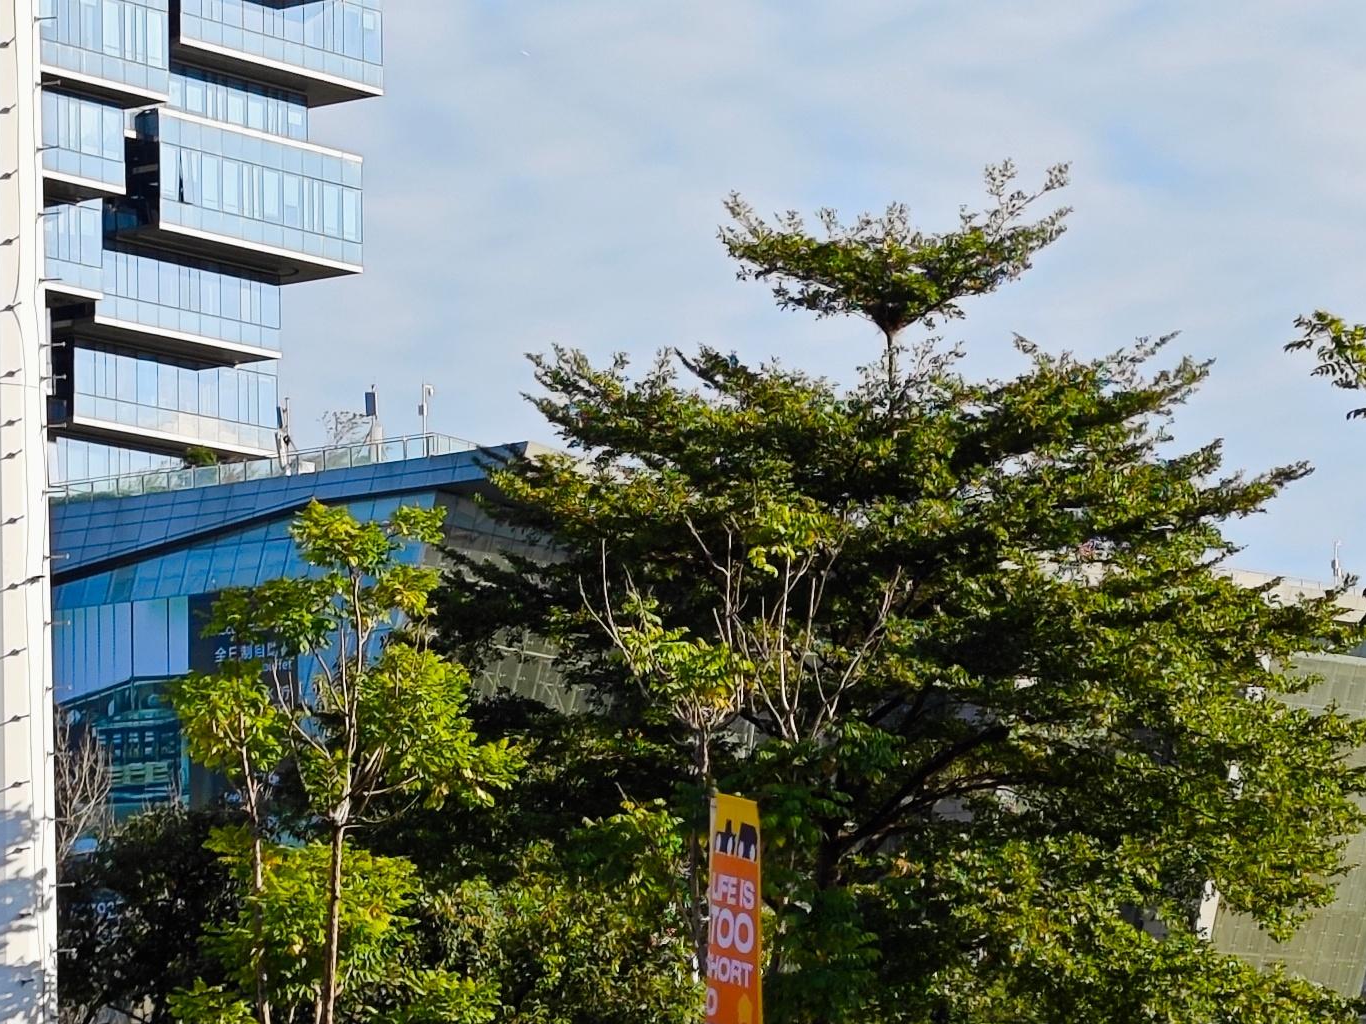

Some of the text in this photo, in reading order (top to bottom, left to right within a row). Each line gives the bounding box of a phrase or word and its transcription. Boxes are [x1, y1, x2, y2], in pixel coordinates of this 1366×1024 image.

[739, 879, 756, 911] IS
[711, 904, 754, 954] TOO
[706, 953, 754, 990] HORT
[706, 987, 718, 1017] O
